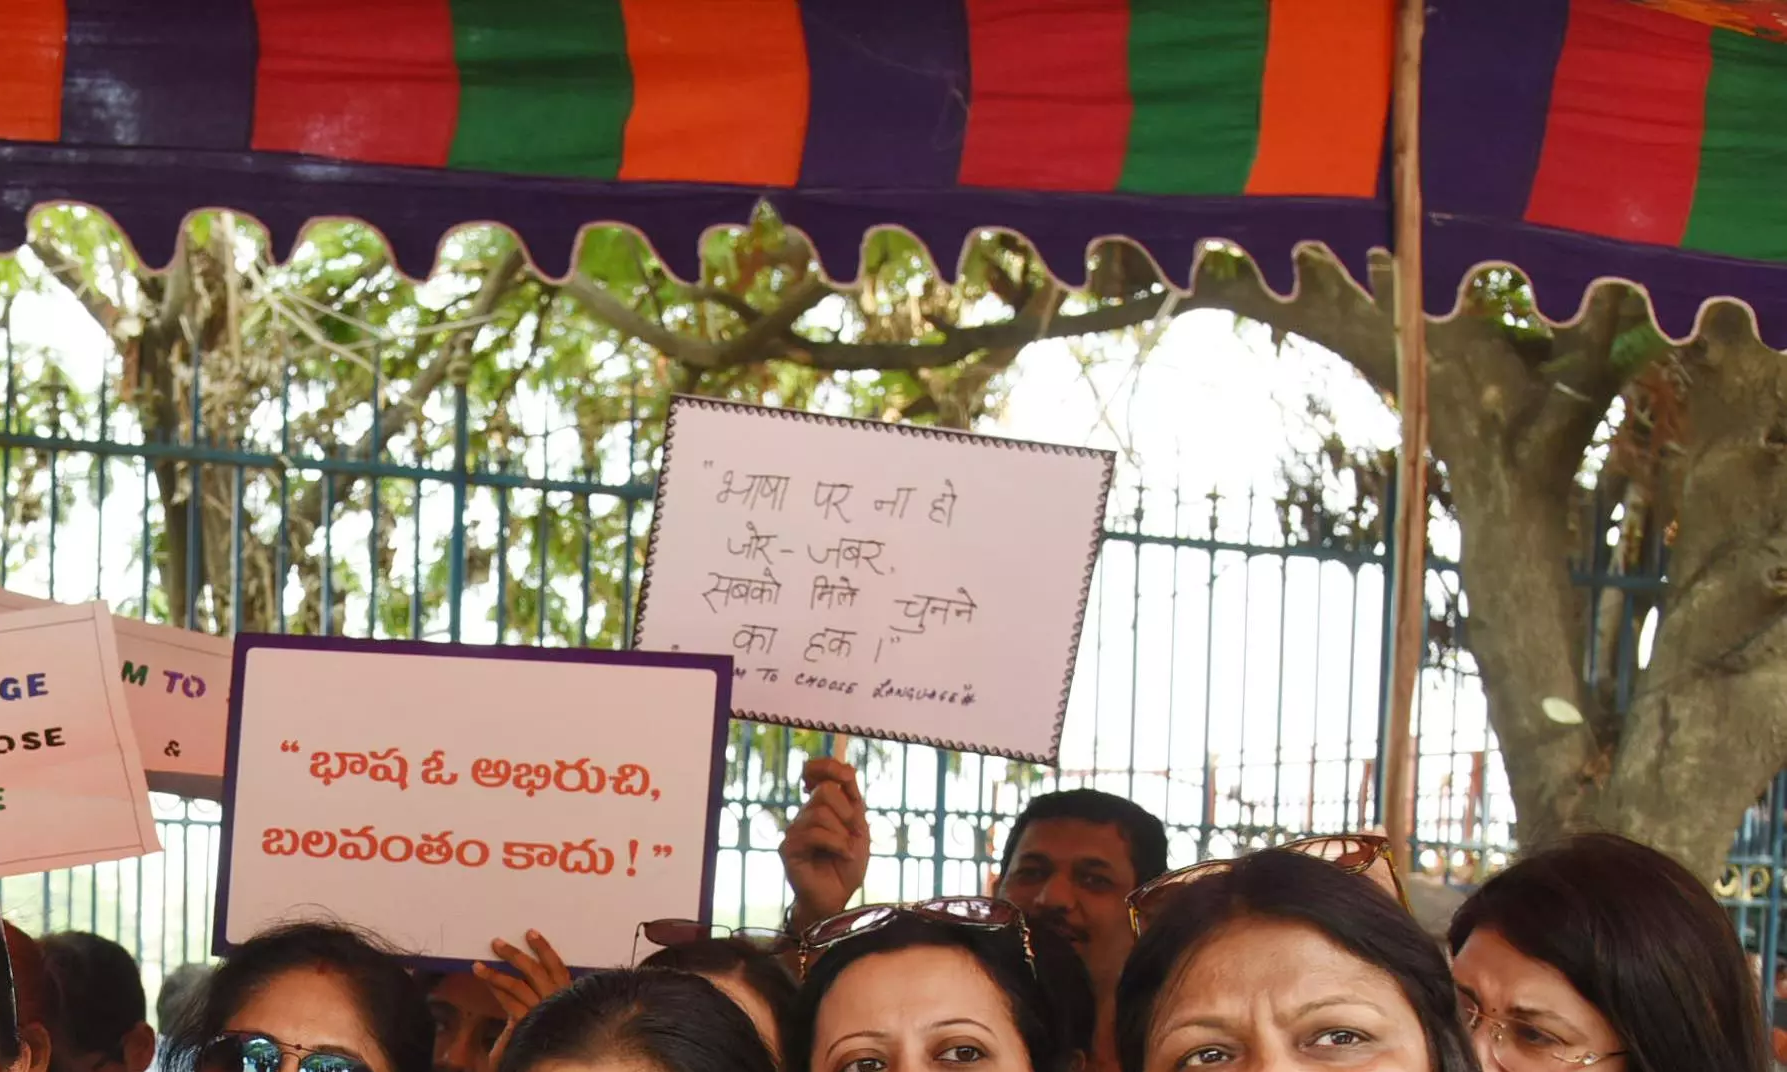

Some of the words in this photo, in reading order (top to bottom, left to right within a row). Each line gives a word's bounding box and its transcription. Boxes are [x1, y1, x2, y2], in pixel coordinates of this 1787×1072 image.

[813, 481, 852, 523] पर
[873, 486, 917, 520] ना
[928, 478, 958, 527] हो
[701, 567, 782, 614] सबको
[810, 575, 860, 611] मिले
[889, 586, 978, 635] चुनने
[732, 623, 779, 657] का
[803, 627, 858, 664] हक
[162, 669, 207, 699] TO
[756, 668, 779, 683] TO
[794, 672, 859, 694] CHOOSE
[163, 739, 182, 758] &
[309, 746, 409, 792] భాష
[421, 749, 458, 787] ఓ
[470, 756, 661, 803] అభిరుచి,
[261, 824, 490, 868] బలవంతం
